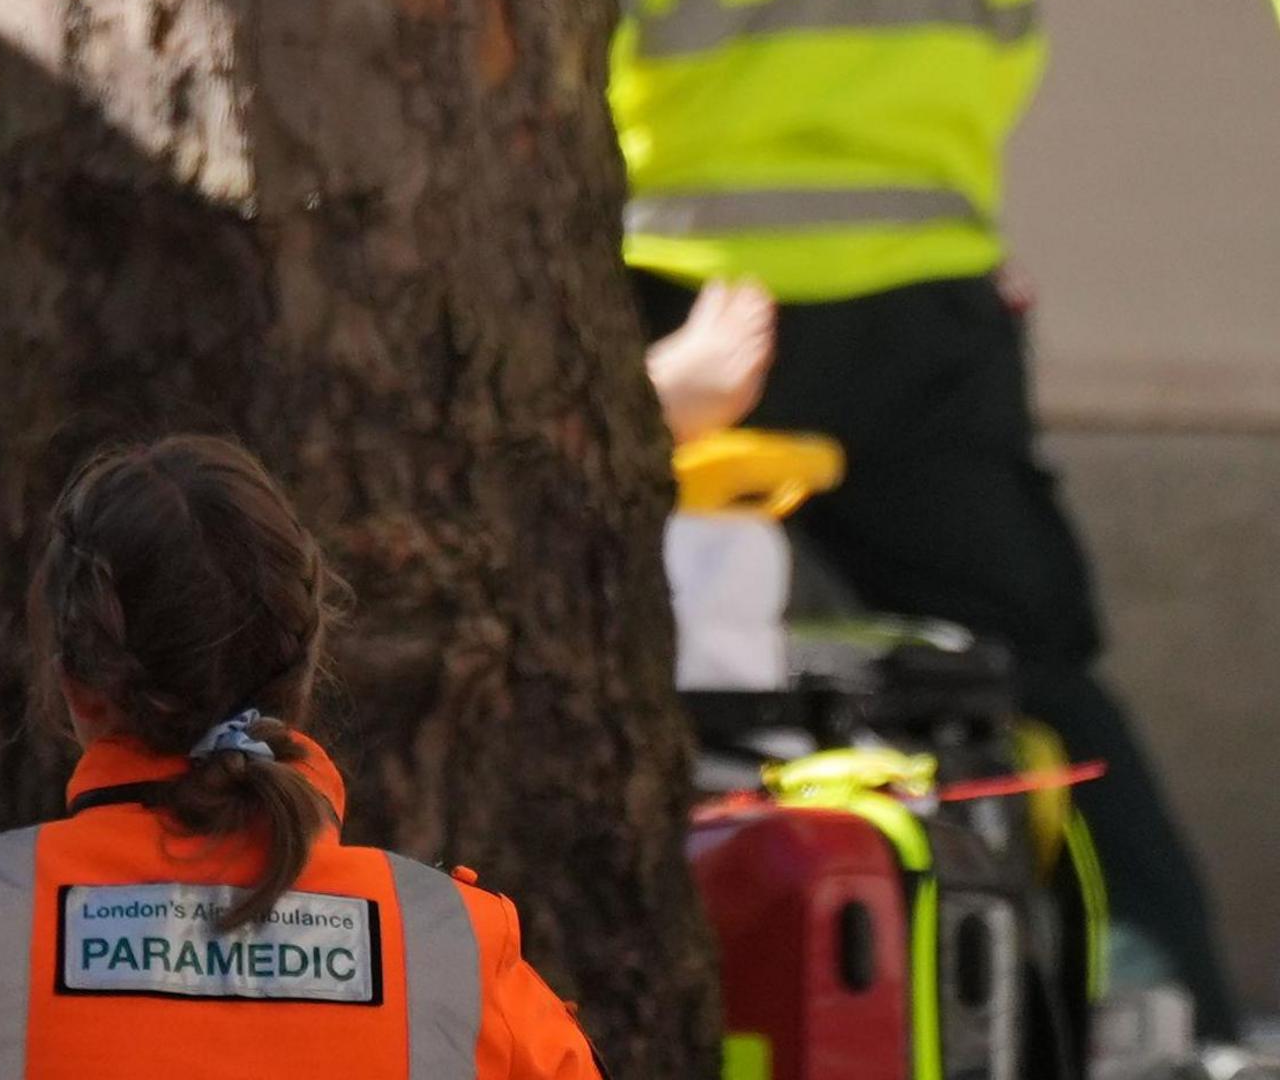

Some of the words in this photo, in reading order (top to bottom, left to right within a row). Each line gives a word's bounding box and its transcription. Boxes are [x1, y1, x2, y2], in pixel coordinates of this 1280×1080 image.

[83, 901, 186, 919] London's
[192, 904, 225, 921] Air
[261, 905, 354, 930] bulance
[81, 937, 357, 983] PARAMEDIC
